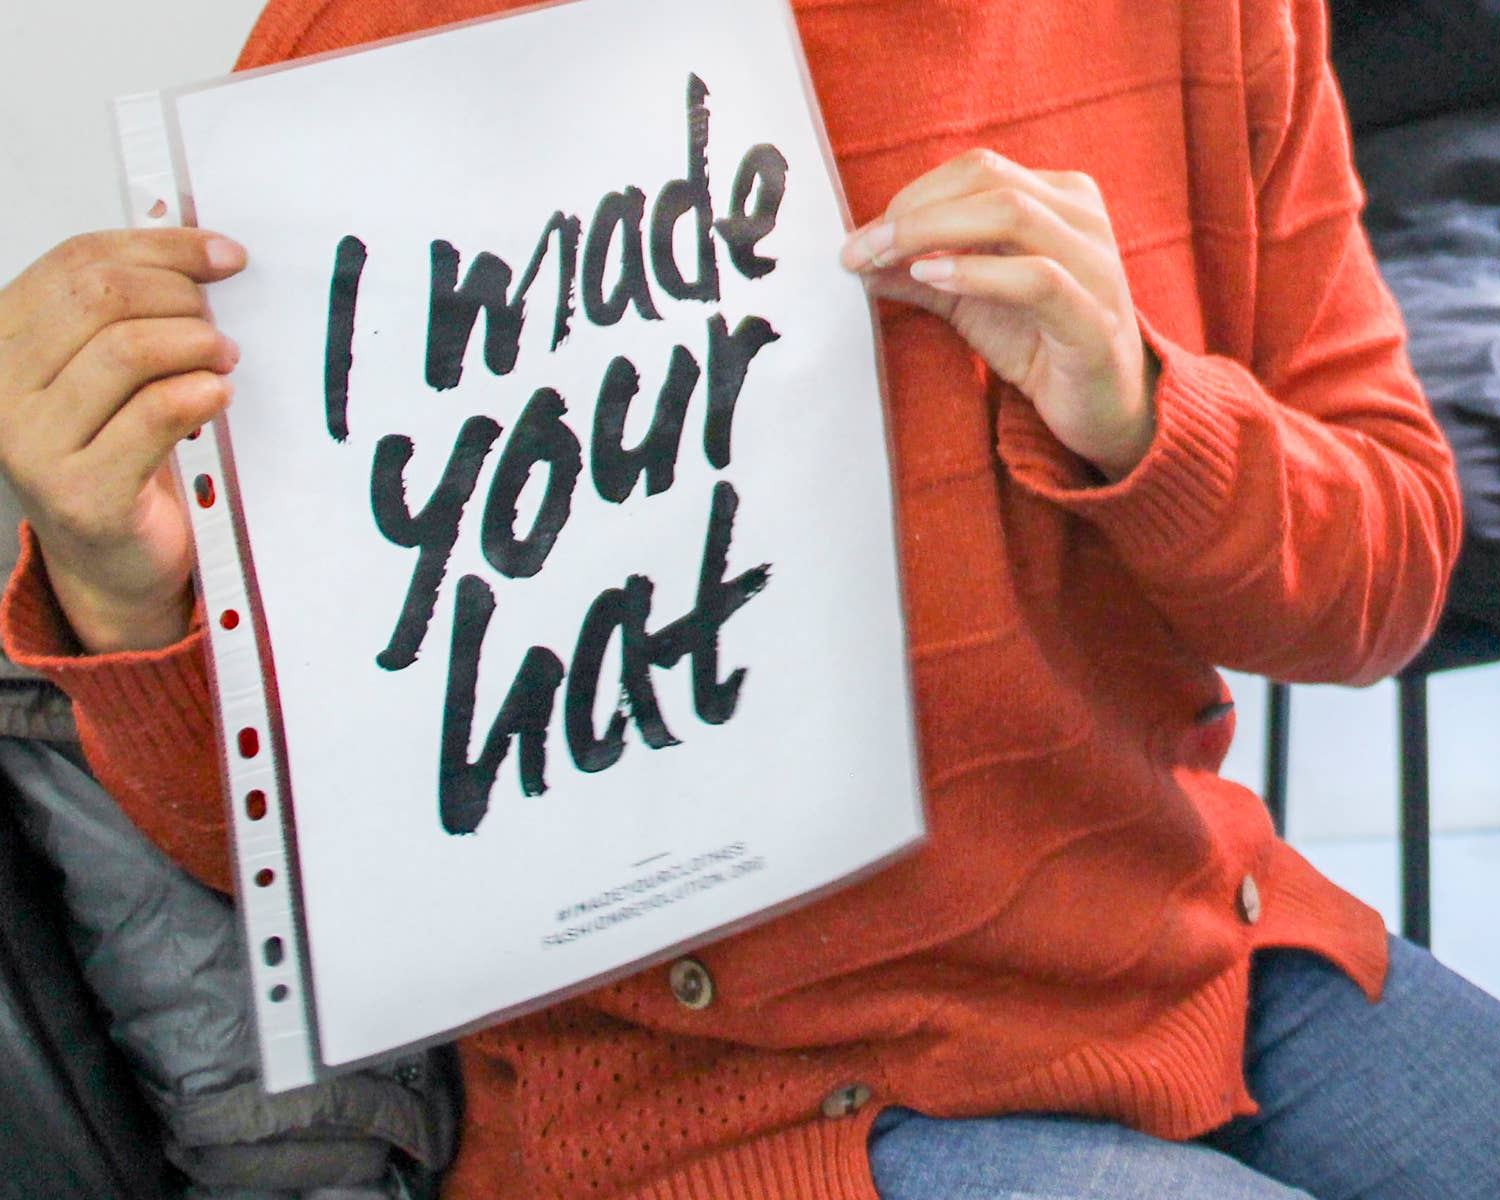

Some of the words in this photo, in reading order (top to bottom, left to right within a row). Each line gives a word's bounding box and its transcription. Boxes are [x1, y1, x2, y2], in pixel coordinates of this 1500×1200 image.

[323, 235, 369, 444] I
[425, 73, 789, 393] made
[370, 313, 782, 672] your
[438, 480, 773, 836] hat
